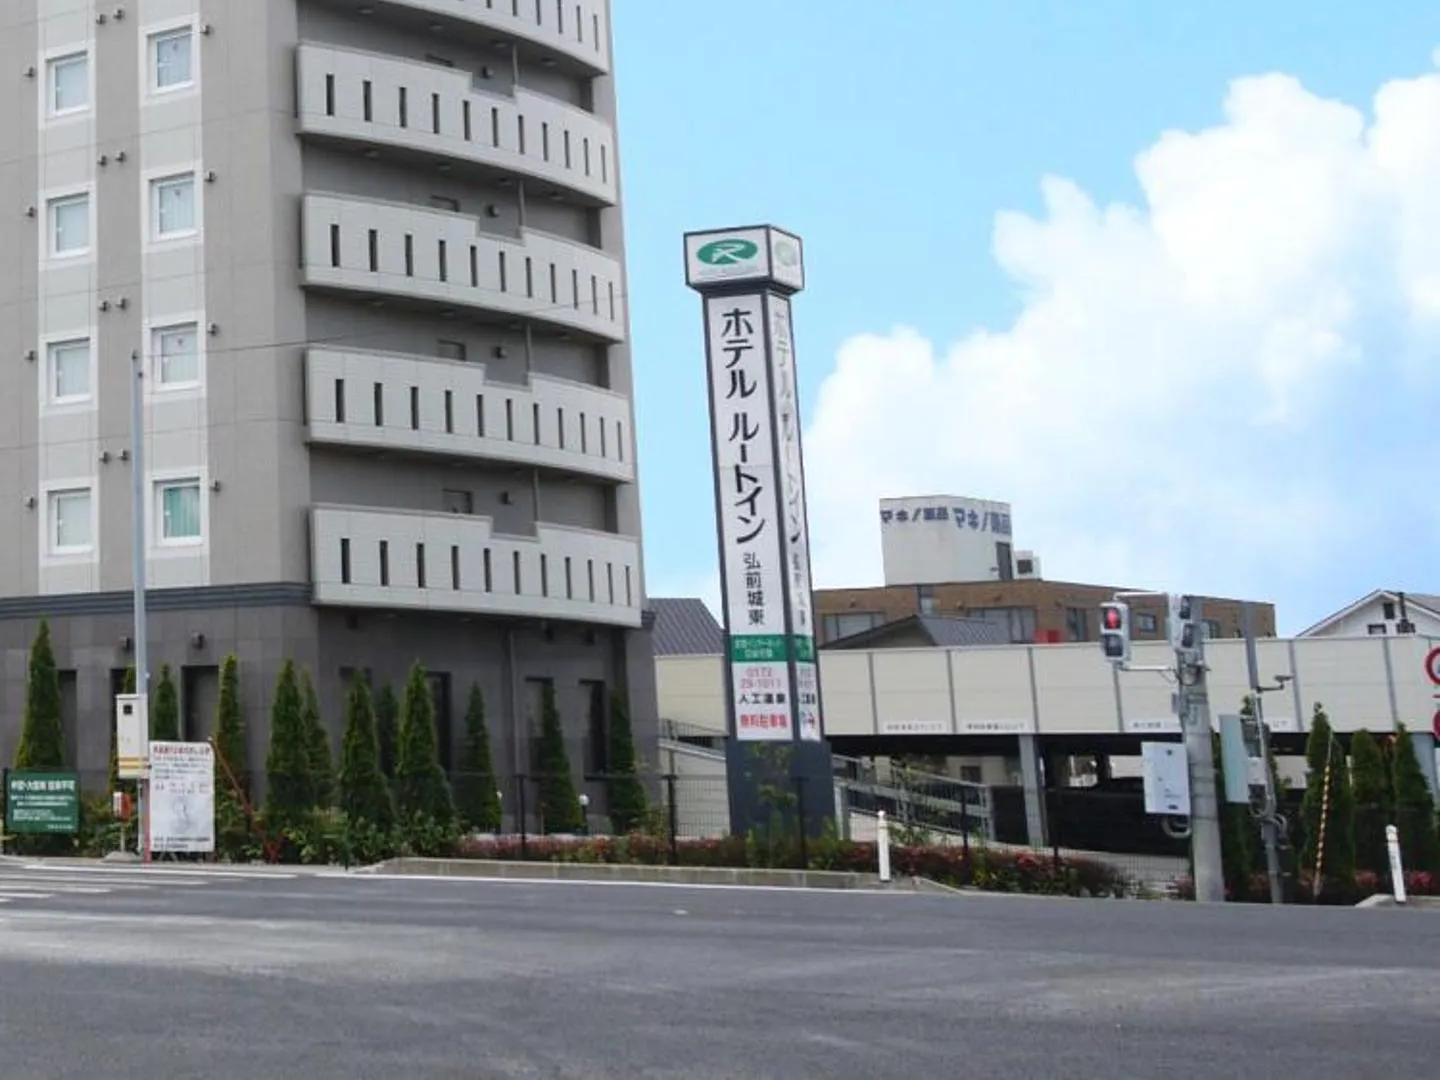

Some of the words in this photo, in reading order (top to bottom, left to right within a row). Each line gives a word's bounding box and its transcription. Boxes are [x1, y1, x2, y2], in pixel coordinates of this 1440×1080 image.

[720, 307, 757, 400] ホテル
[728, 412, 765, 545] ルートイン
[743, 552, 766, 626] 弘前城東
